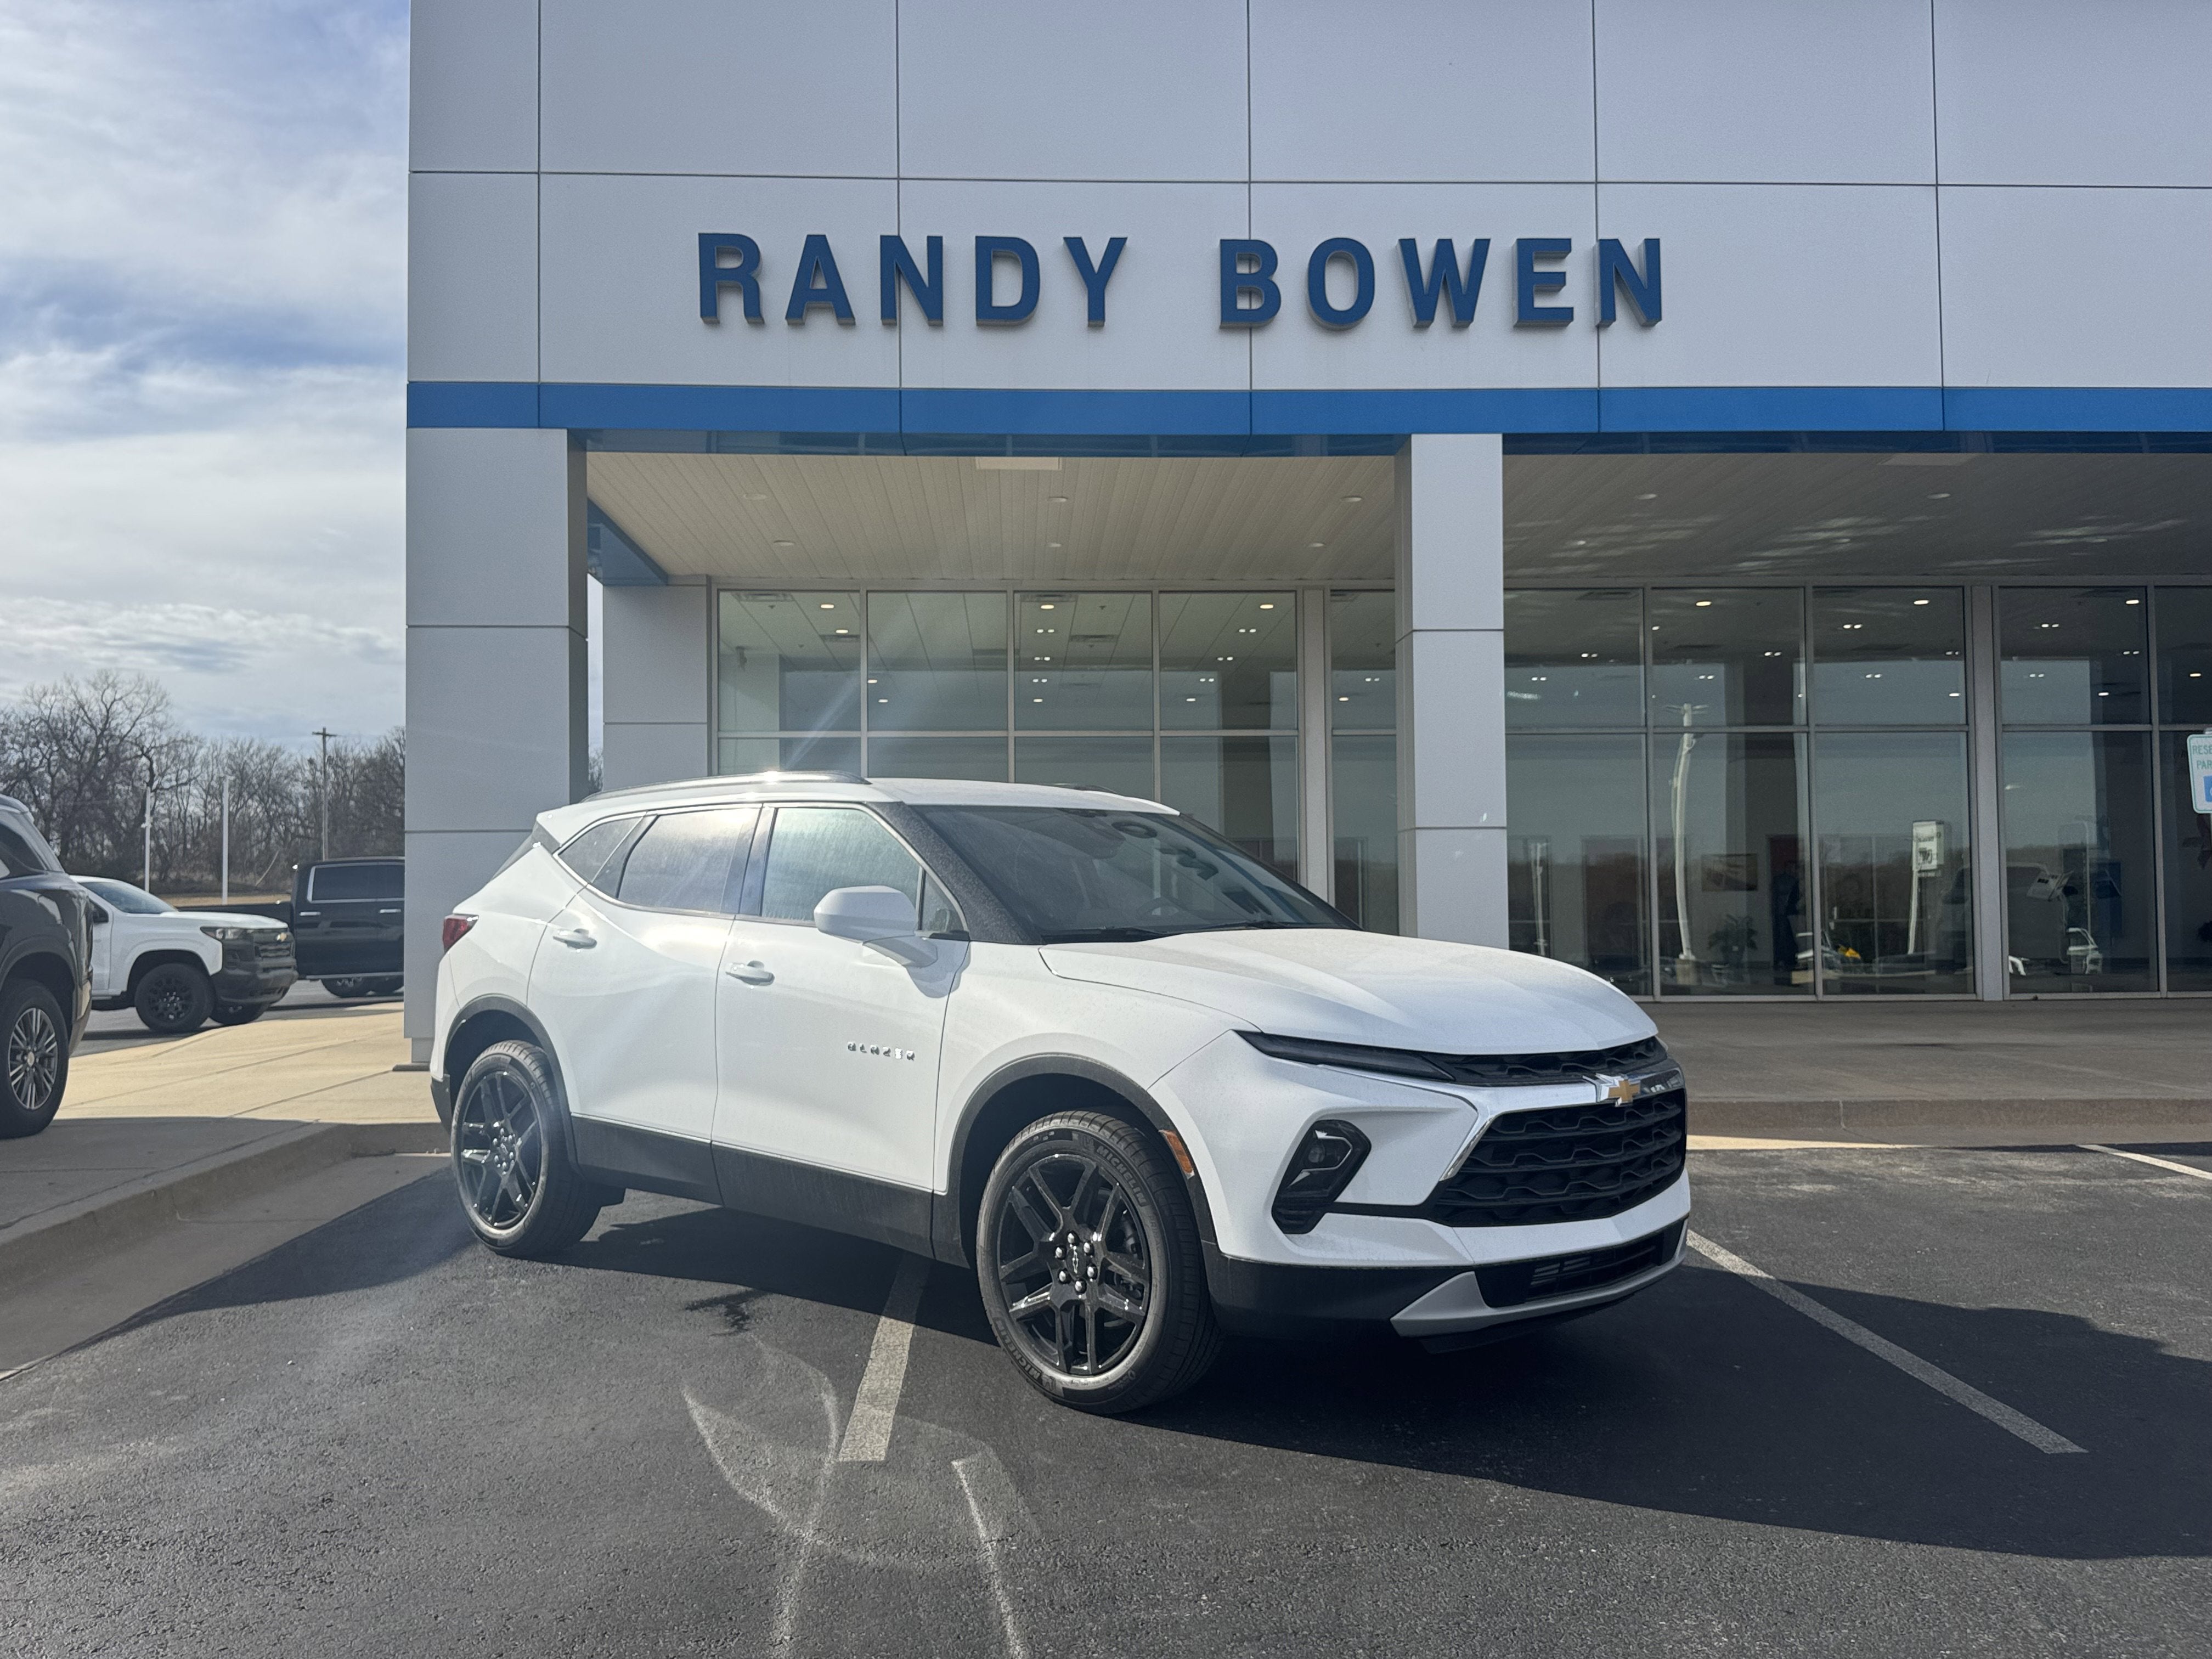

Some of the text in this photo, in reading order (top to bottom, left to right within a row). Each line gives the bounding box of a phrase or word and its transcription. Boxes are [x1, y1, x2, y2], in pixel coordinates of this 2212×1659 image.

[698, 233, 1662, 330] RANDY BOWEN
[848, 1041, 916, 1061] BLAZER
[1097, 1146, 1147, 1205] MICHELIN
[996, 1321, 1041, 1379] MICHELIN
